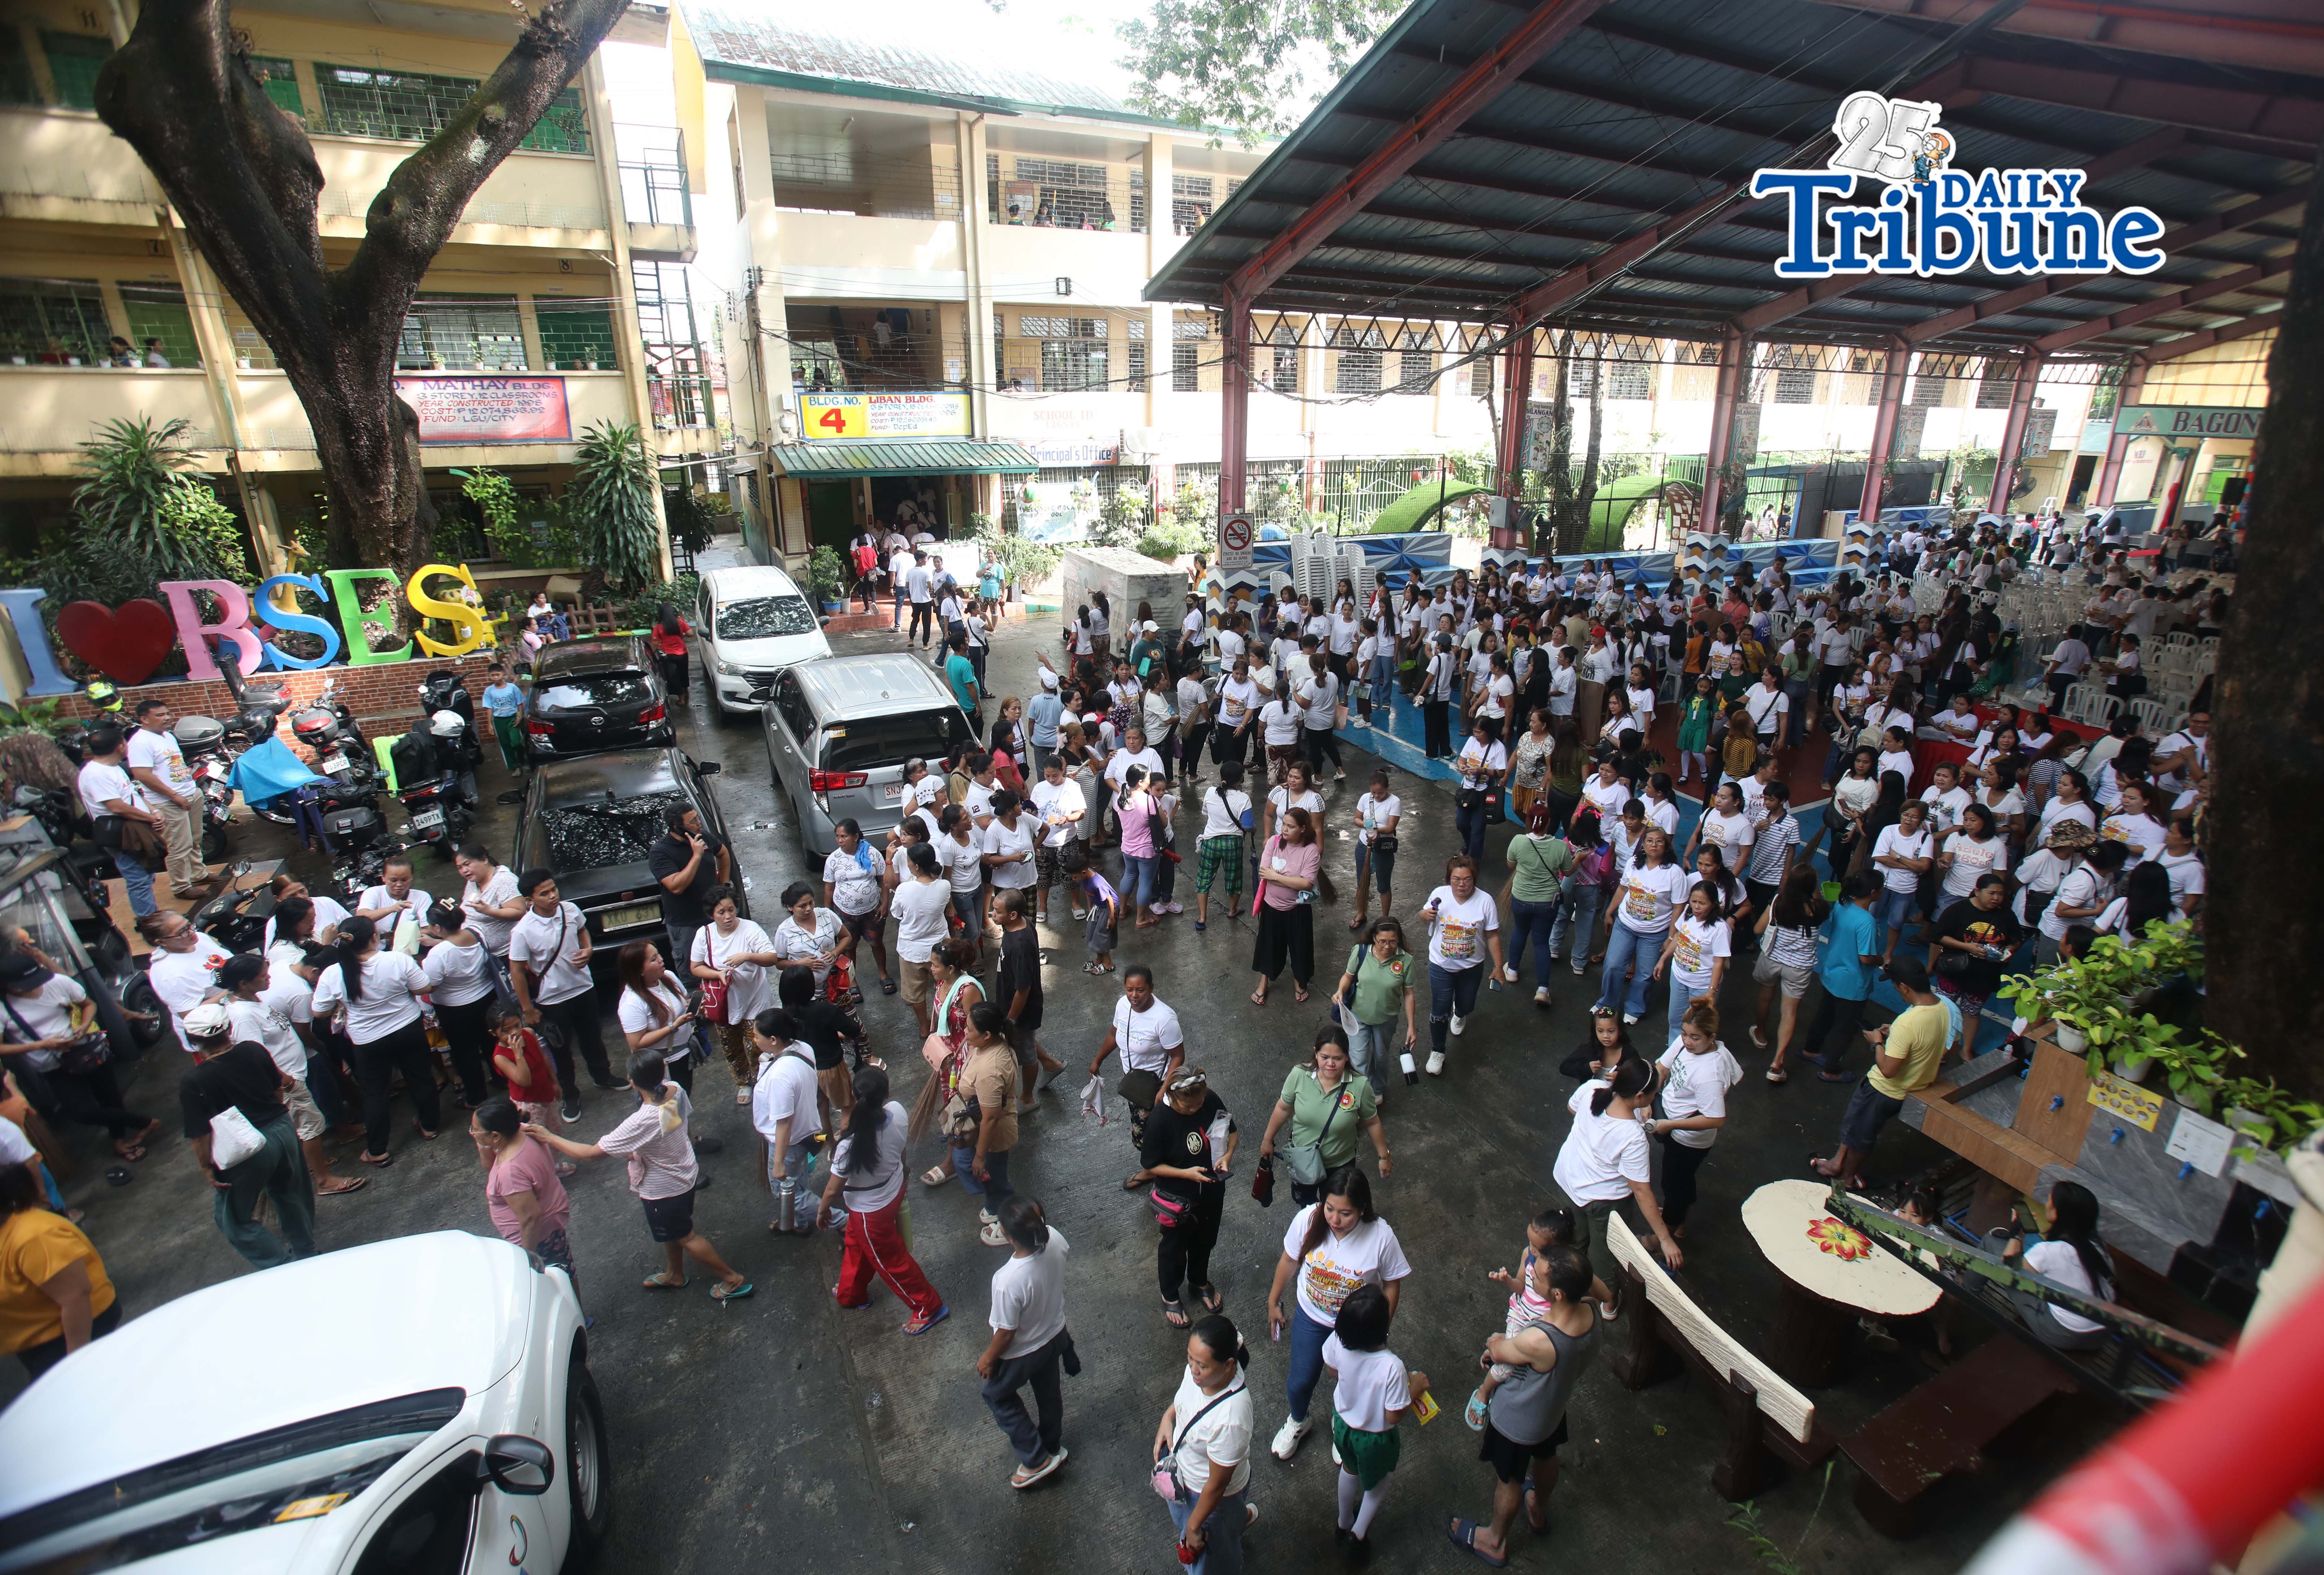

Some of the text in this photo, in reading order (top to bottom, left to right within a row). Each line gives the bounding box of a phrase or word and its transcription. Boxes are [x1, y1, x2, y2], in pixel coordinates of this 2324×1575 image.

[423, 380, 508, 390] MATHAY
[809, 397, 842, 406] BLDG.
[869, 395, 901, 404] LIBAN
[820, 408, 846, 433] 4
[1033, 410, 1075, 420] SCHOOL
[1521, 419, 1532, 466] MASIPAG
[1082, 445, 1111, 460] Office
[160, 564, 482, 681] BSES
[971, 805, 980, 814] 12
[415, 812, 441, 826] 149PTX
[1955, 843, 1995, 859] Adele
[1646, 893, 1657, 901] 26
[1691, 942, 1702, 953] 26
[1310, 1273, 1342, 1287] ESKWELA
[1313, 1266, 1341, 1281] BRIGADA
